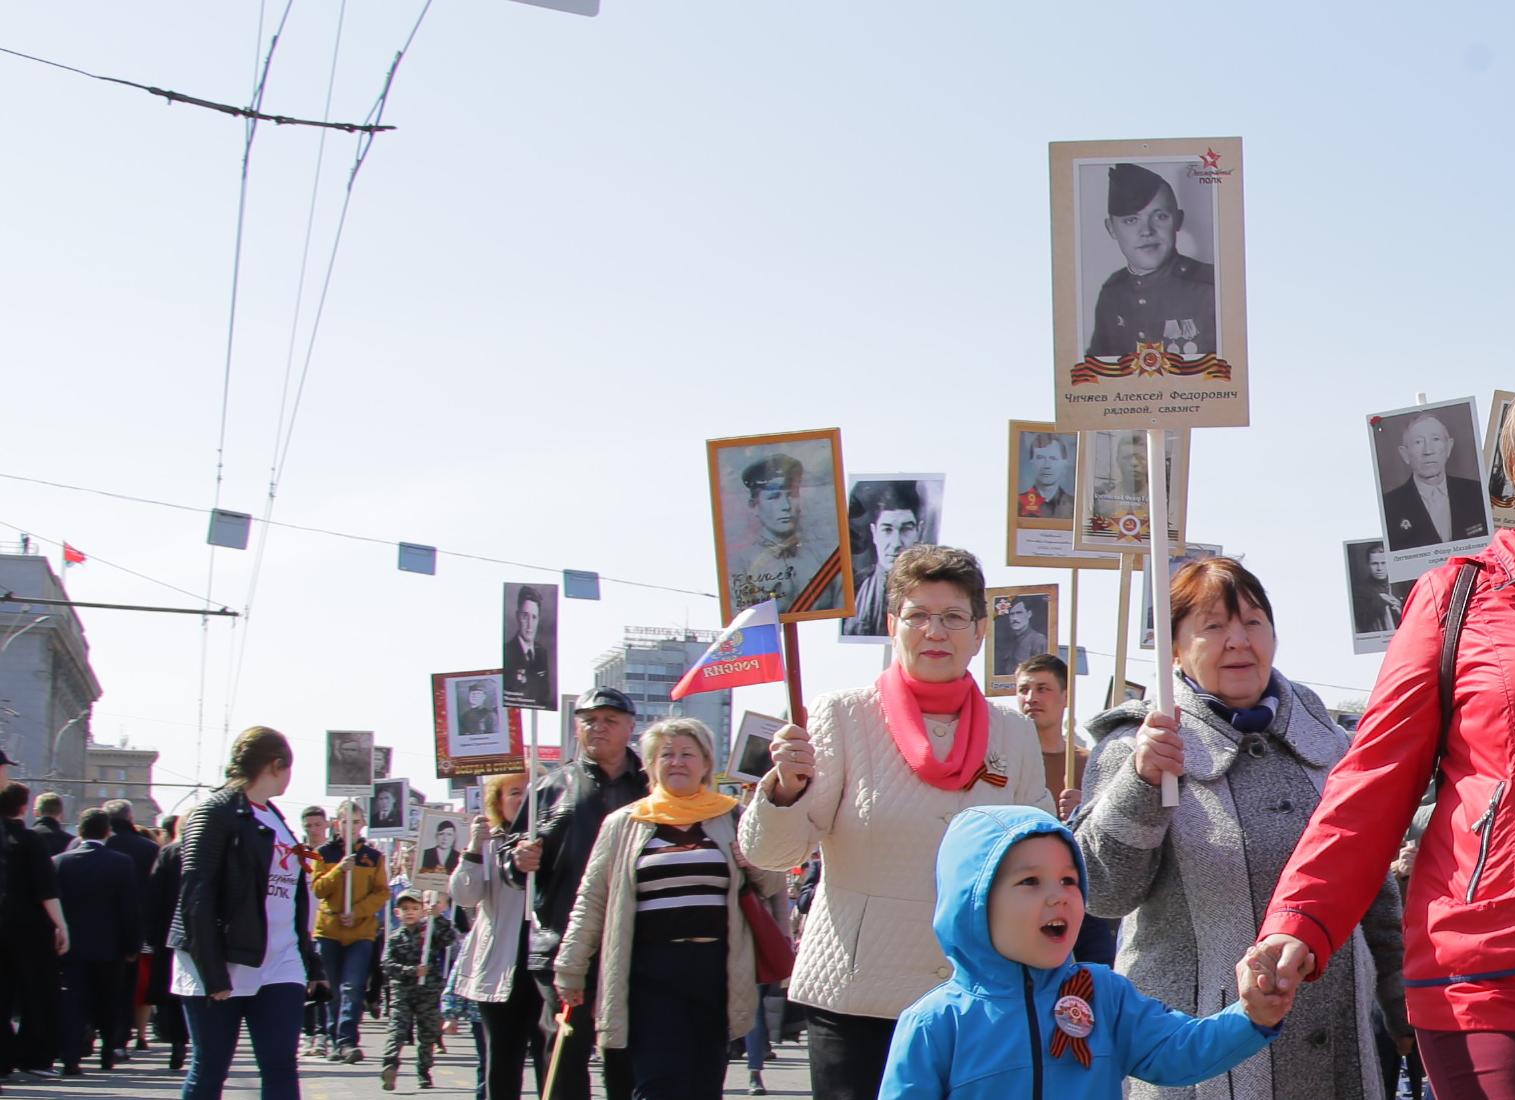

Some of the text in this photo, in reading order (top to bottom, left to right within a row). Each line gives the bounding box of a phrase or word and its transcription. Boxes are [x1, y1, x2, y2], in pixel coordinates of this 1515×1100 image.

[1113, 391, 1163, 402] Алексей
[1169, 390, 1238, 402] Федорович
[1158, 404, 1201, 414] связист
